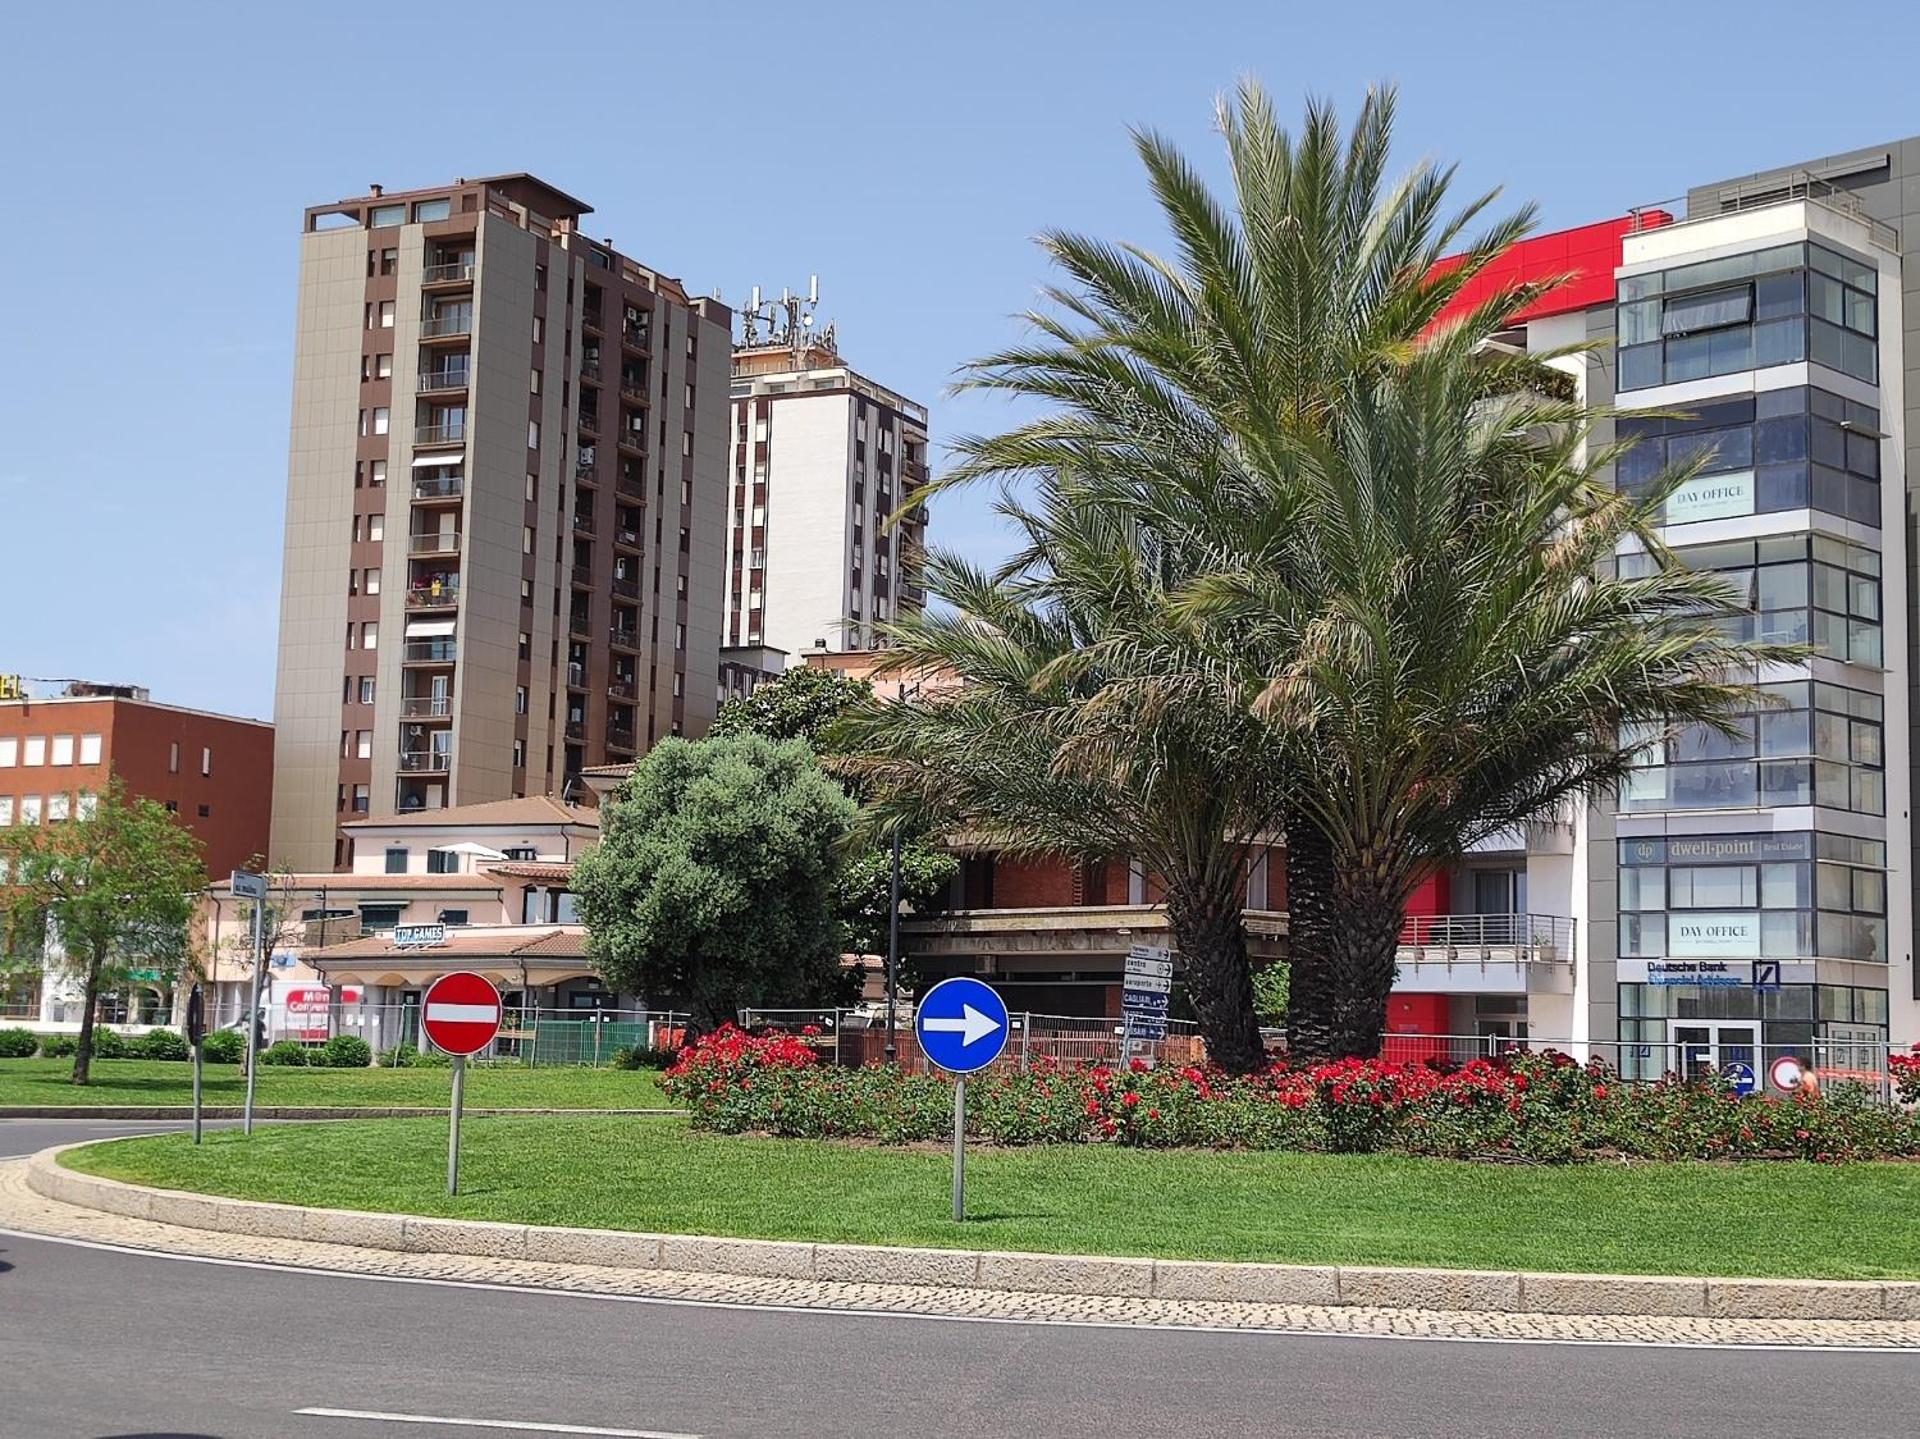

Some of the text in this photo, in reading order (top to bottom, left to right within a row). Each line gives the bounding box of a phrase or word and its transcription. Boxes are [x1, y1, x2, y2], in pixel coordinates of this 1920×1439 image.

[1678, 486, 1744, 504] DAY OFFICE
[396, 927, 442, 940] TOP GAMES
[1681, 926, 1748, 936] DAY OFFICE
[1647, 961, 1727, 972] Deutsche Bank
